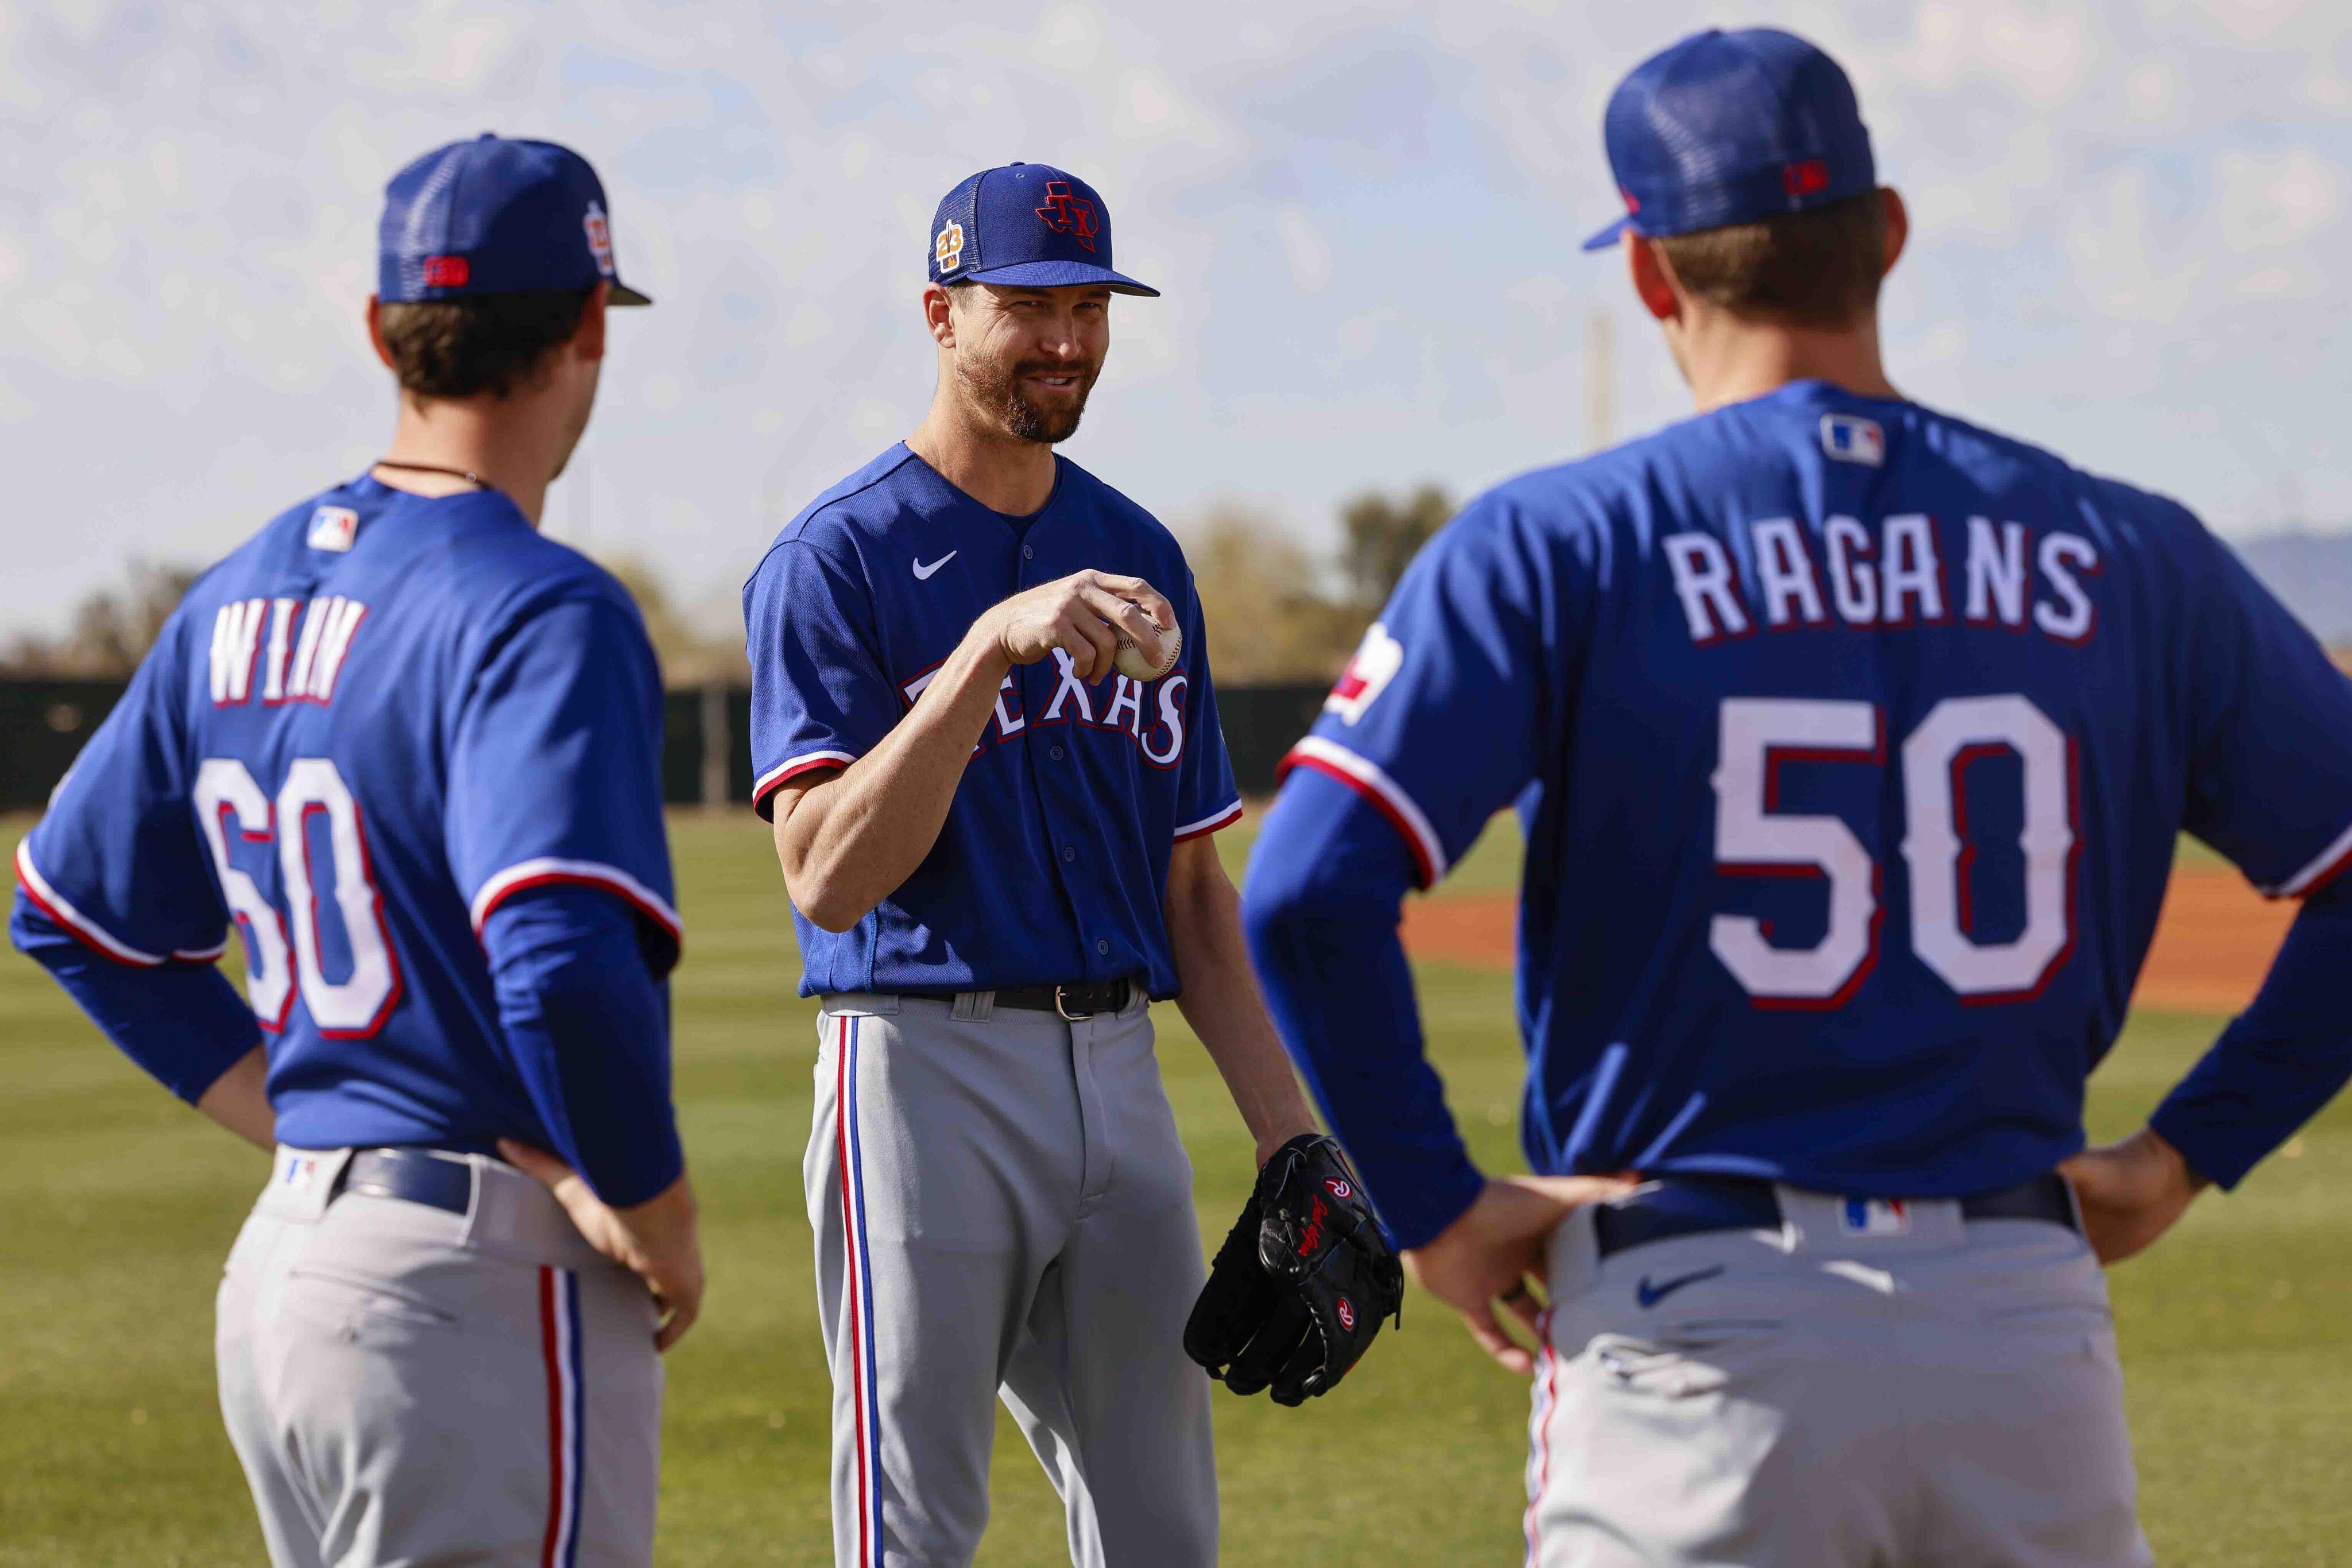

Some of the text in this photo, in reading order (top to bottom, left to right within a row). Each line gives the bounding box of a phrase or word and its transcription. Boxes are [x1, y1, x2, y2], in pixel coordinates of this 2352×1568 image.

[938, 227, 962, 258] 23
[1662, 513, 2103, 648] RAGANS
[898, 646, 1188, 770] EXAS
[193, 757, 402, 1038] 60
[1709, 692, 2083, 1010] 50
